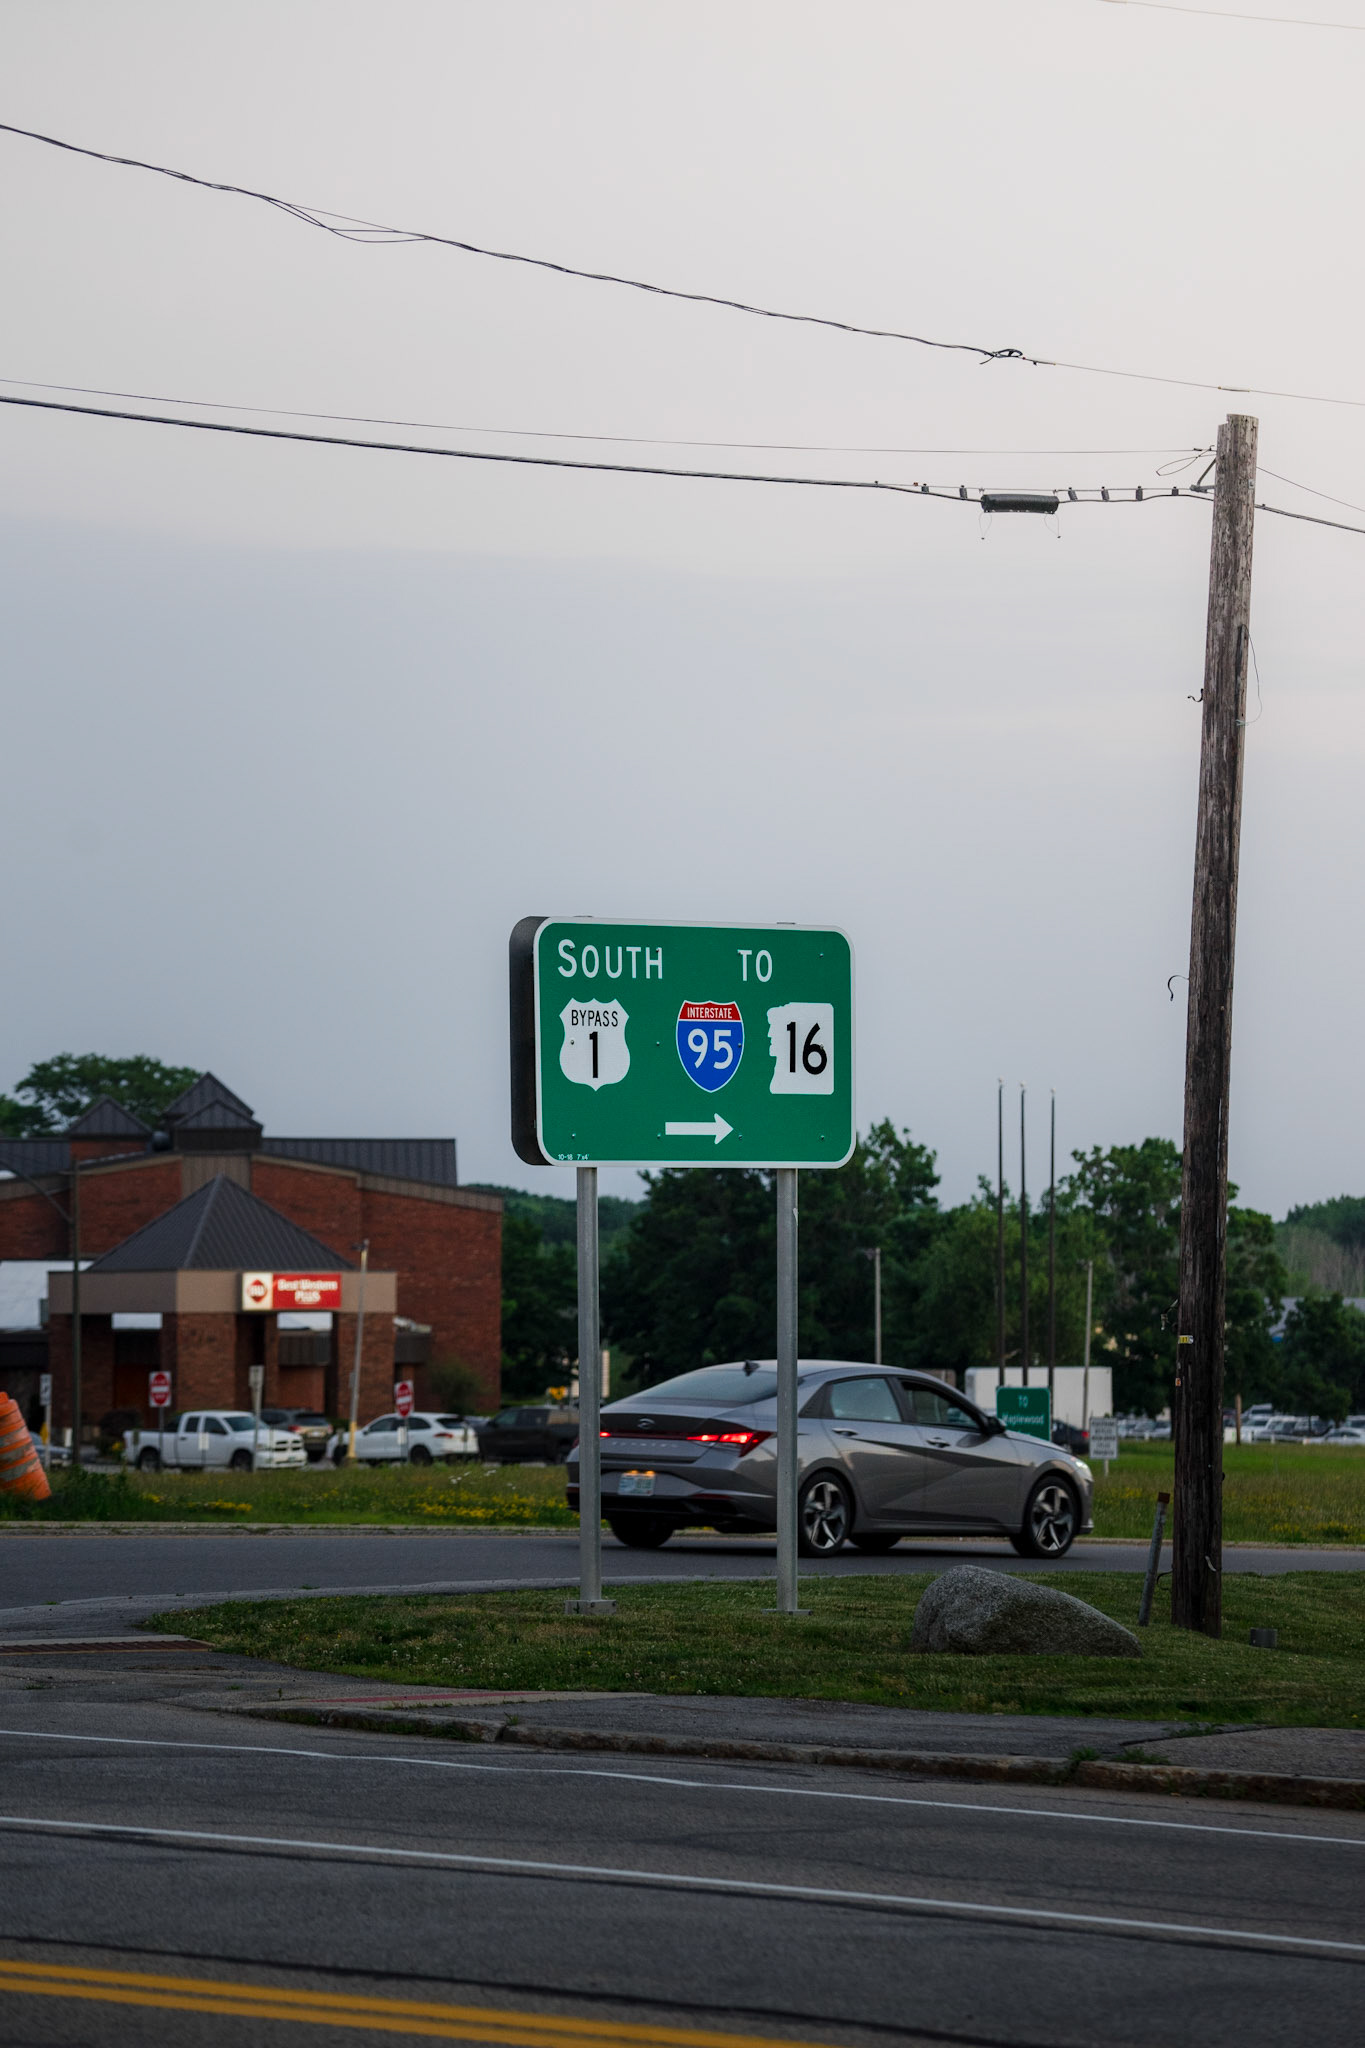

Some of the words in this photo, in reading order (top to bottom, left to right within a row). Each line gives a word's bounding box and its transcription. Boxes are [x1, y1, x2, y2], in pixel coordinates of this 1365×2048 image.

[557, 938, 663, 979] SOUTH
[737, 949, 773, 982] TO
[571, 1009, 619, 1028] BYPASS
[687, 1006, 733, 1020] INTERSTATE
[588, 1031, 600, 1079] 1
[687, 1028, 733, 1070] 95
[786, 1021, 828, 1076] 16
